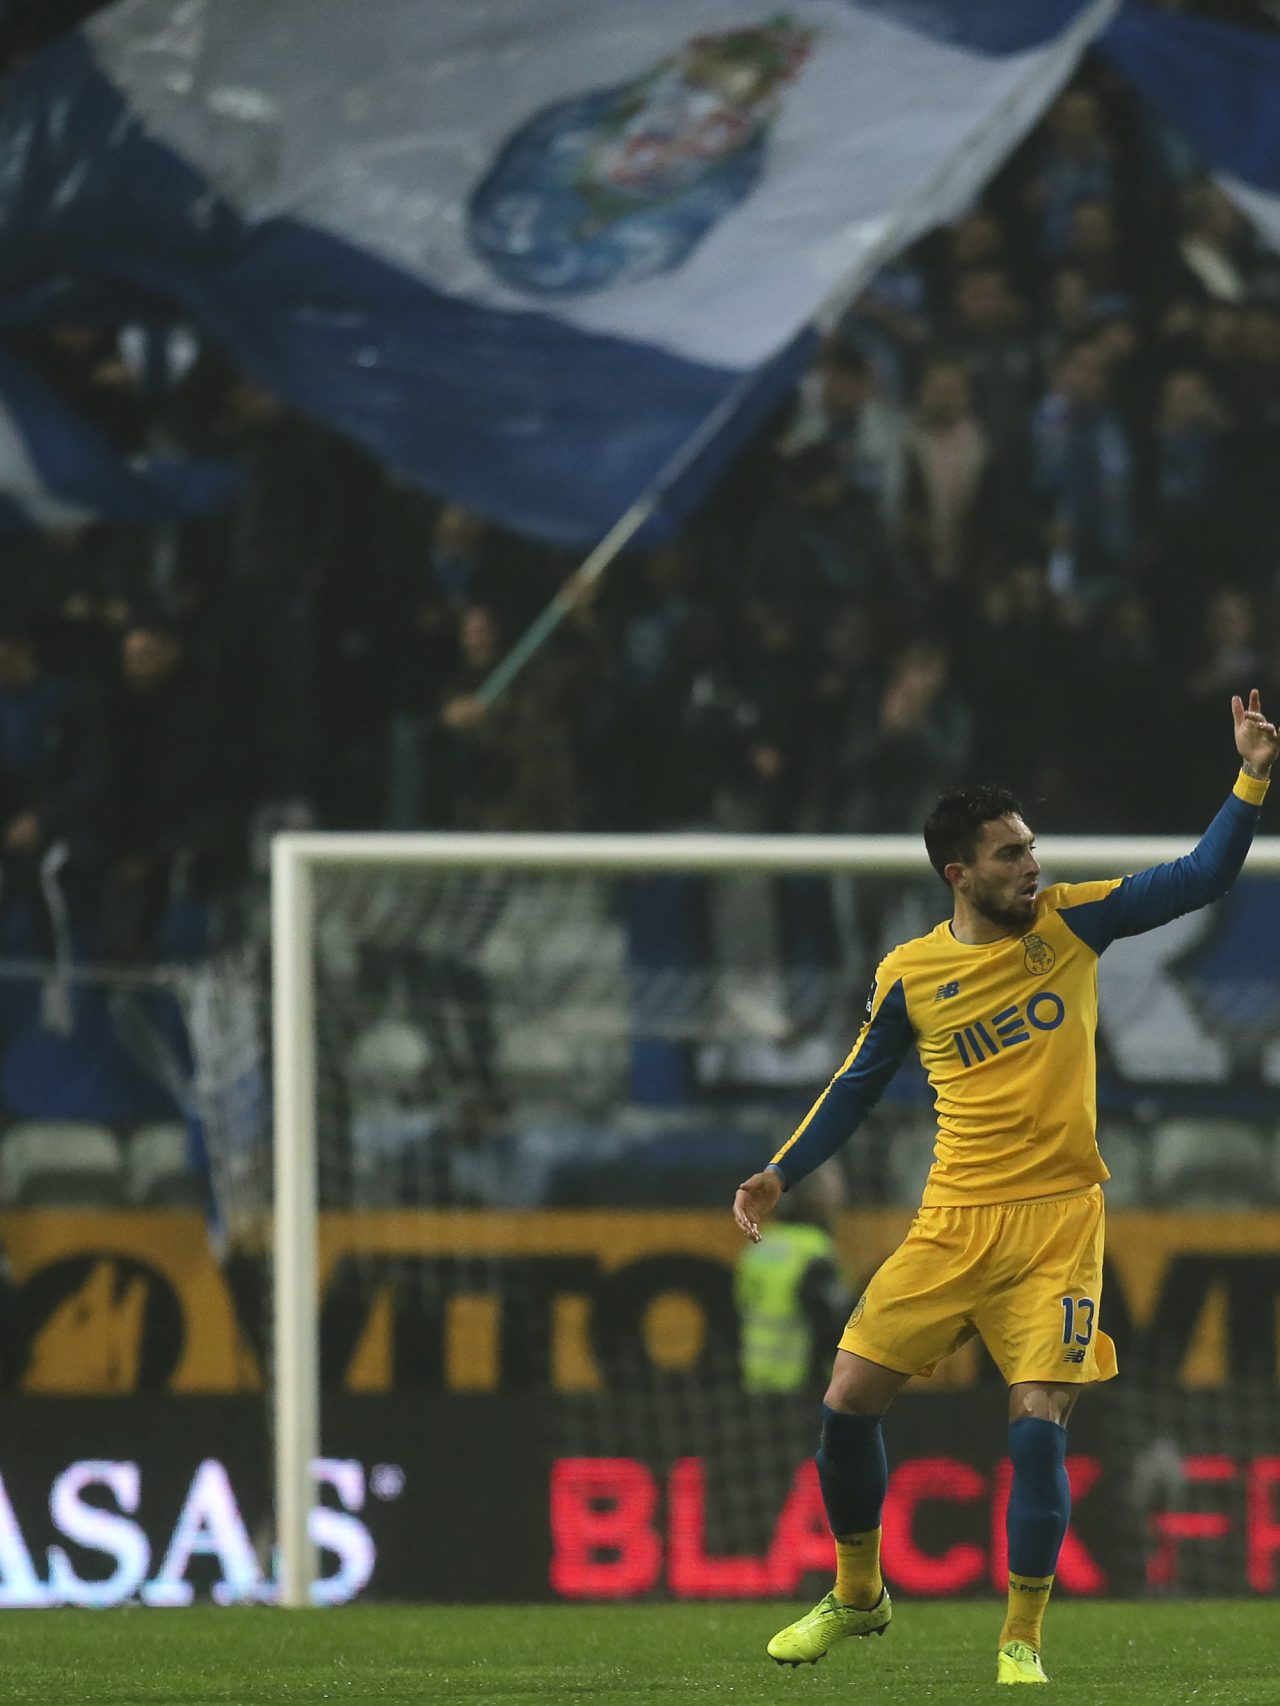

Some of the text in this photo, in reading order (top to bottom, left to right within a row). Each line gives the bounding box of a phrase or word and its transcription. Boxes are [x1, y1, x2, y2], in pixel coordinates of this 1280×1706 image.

[953, 991, 1065, 1068] MEO
[1061, 1296, 1095, 1346] 13
[549, 1456, 1108, 1600] BLACK
